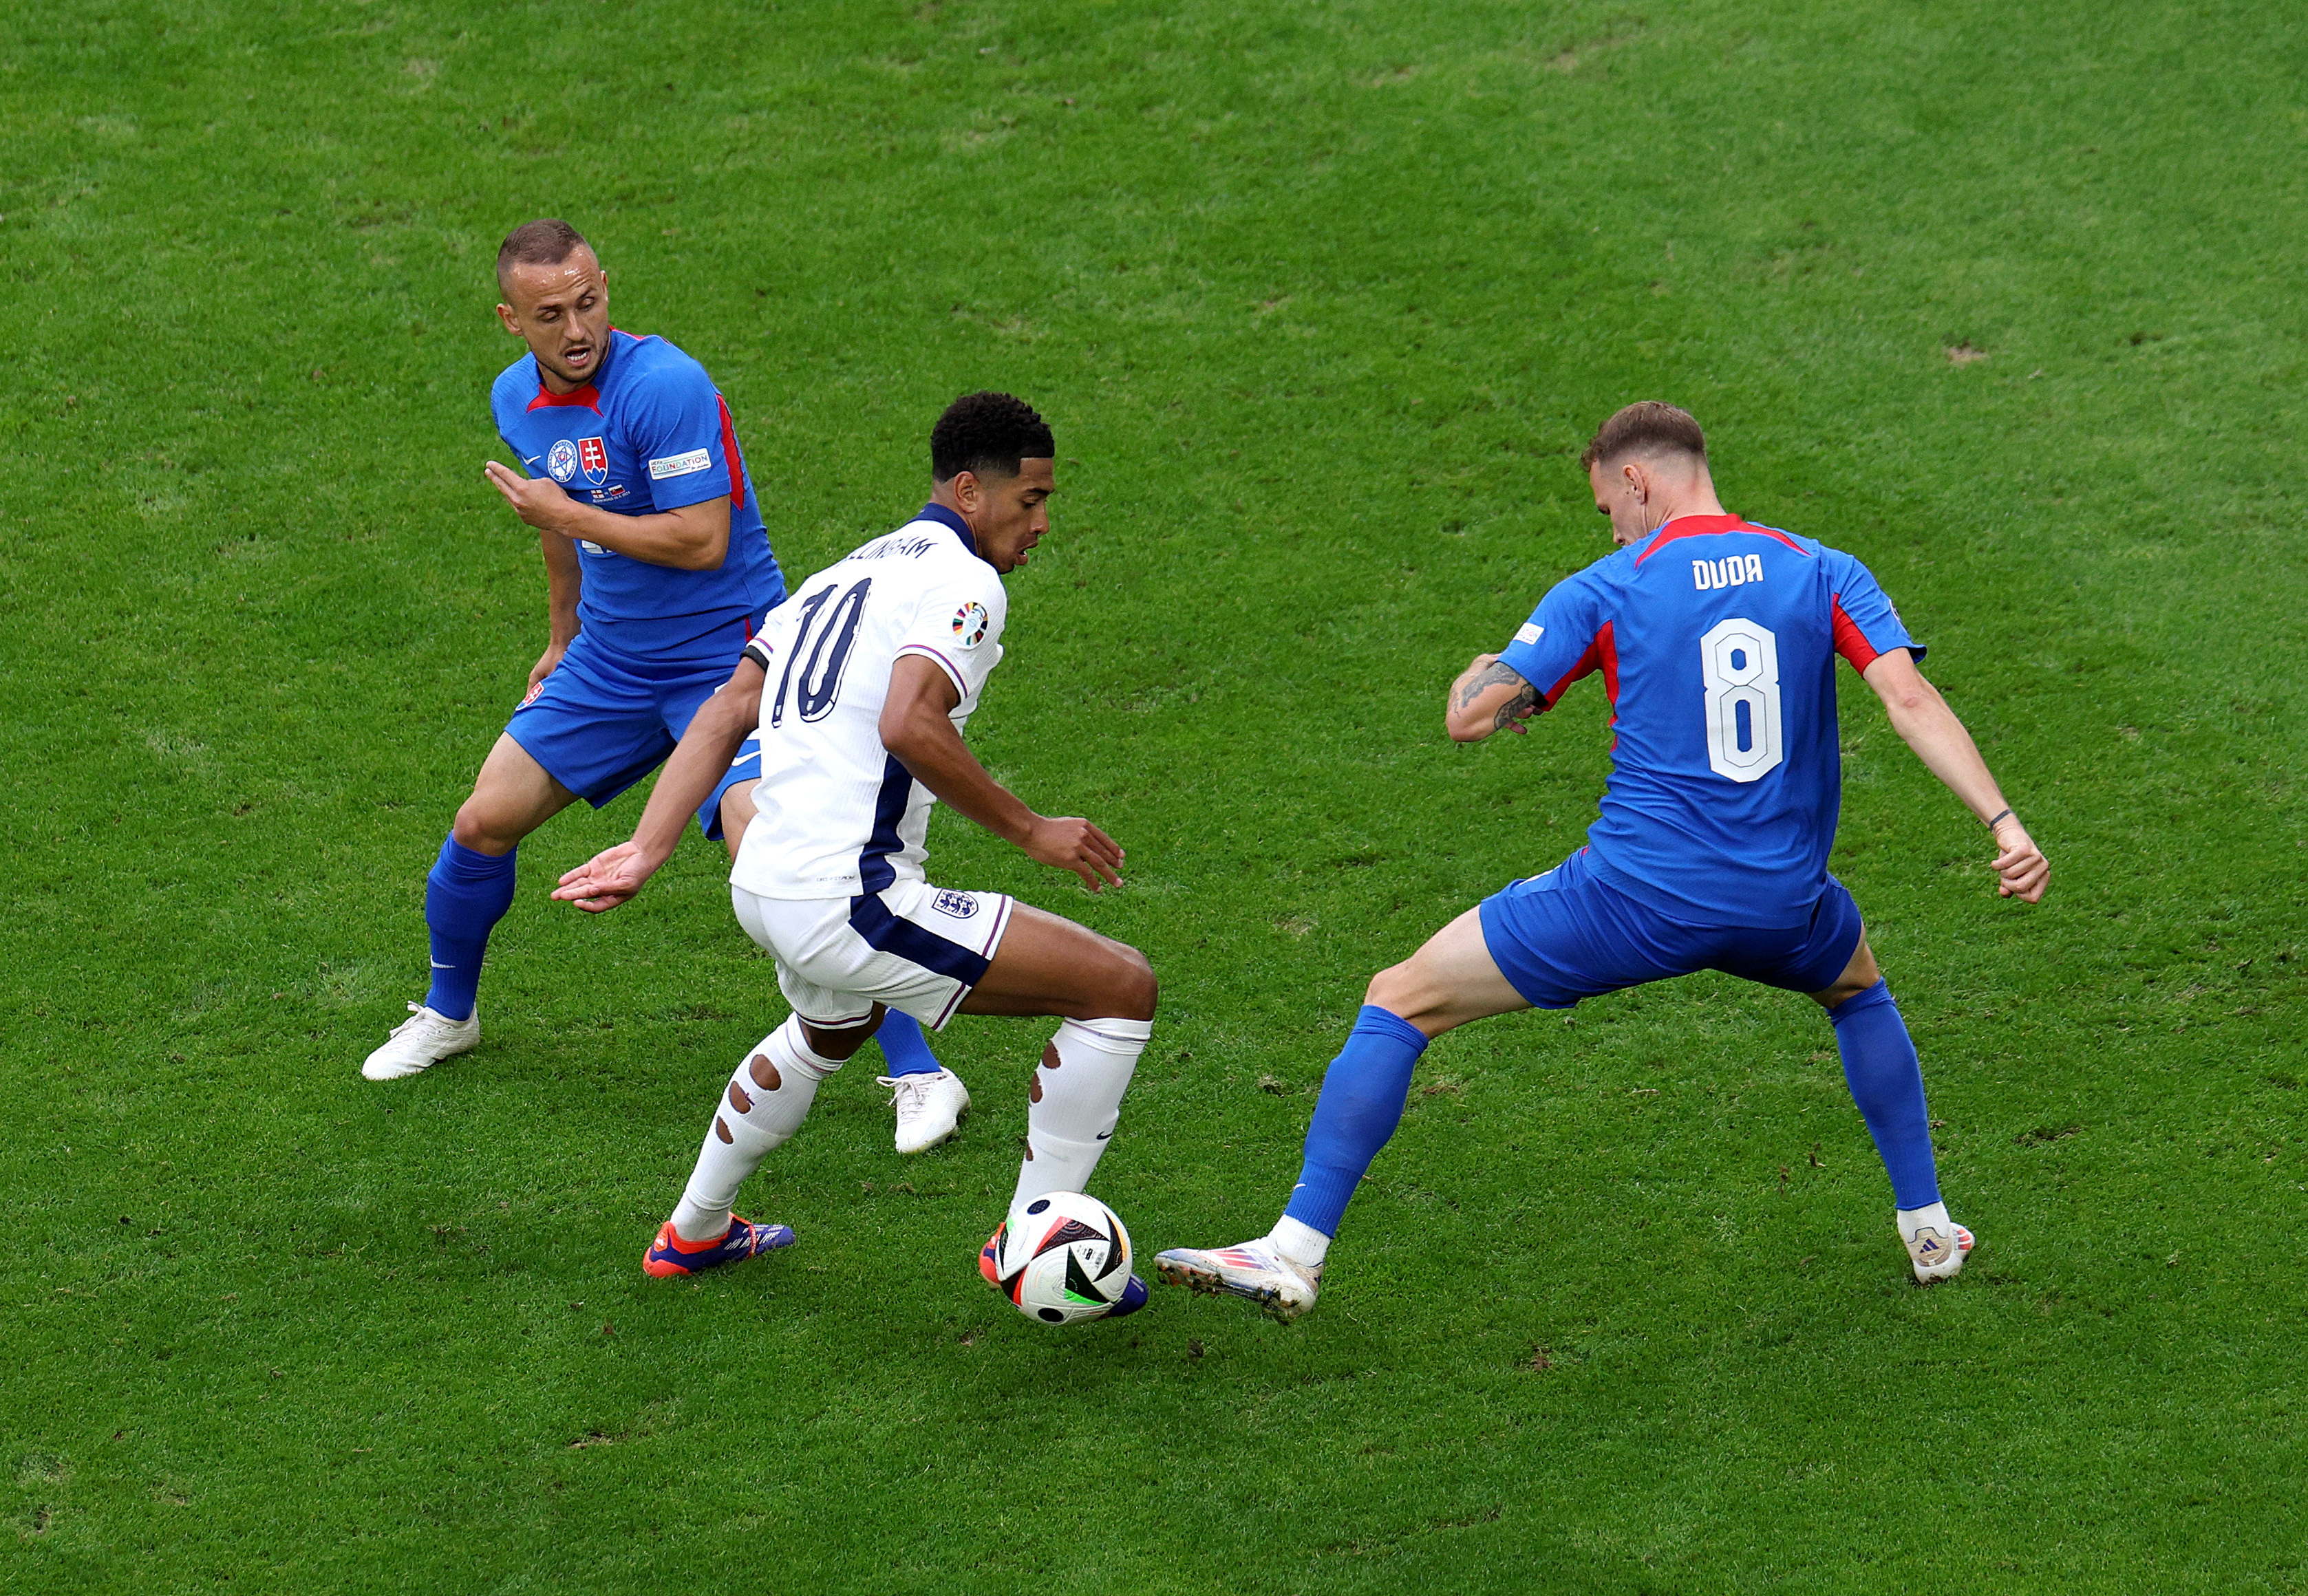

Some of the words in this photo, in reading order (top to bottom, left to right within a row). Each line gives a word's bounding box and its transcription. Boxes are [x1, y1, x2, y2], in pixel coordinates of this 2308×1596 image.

[652, 455, 708, 473] FOUNDATION
[1692, 554, 1764, 591] DUDA
[771, 577, 872, 728] 10
[1700, 617, 1784, 784] 8
